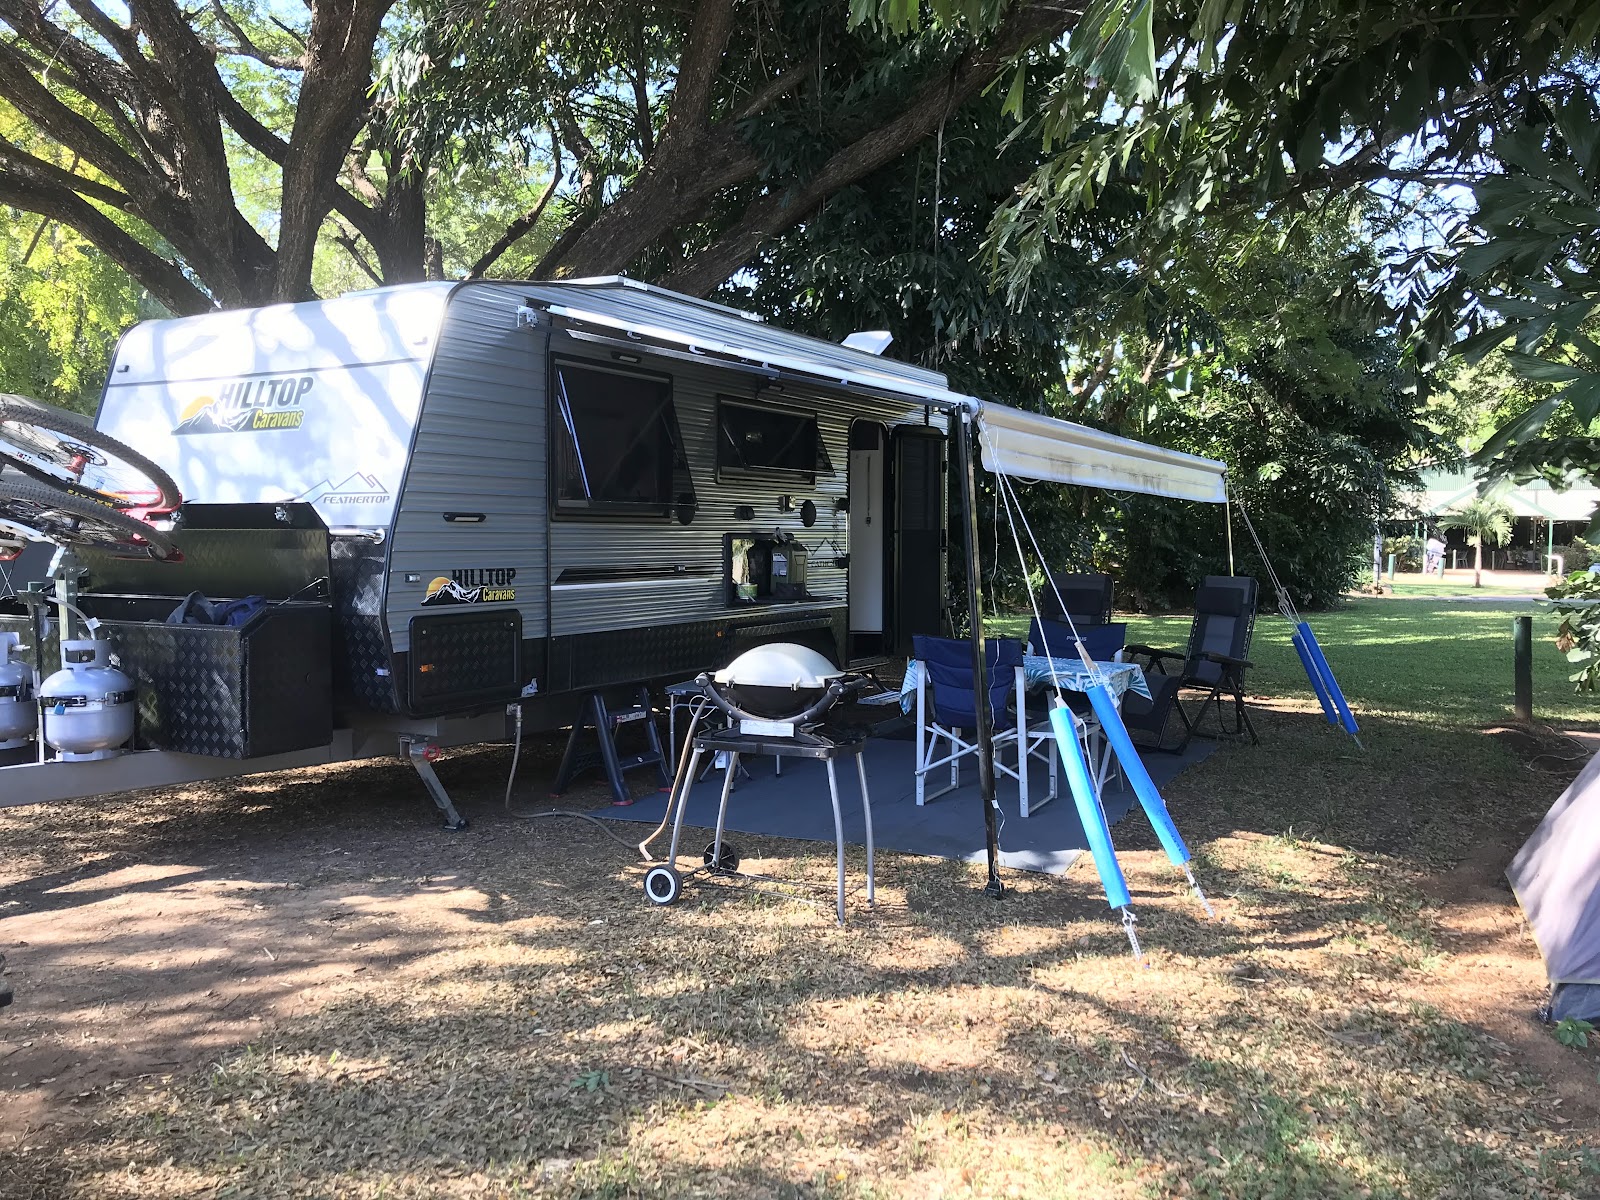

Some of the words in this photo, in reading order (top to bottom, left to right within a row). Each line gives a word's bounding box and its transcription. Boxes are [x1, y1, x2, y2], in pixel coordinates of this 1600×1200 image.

[220, 377, 314, 408] HILLTOP
[252, 409, 304, 429] Caravans
[323, 495, 390, 504] FEATHERTOP
[452, 568, 517, 588] HILLTOP
[482, 587, 515, 602] Caravans
